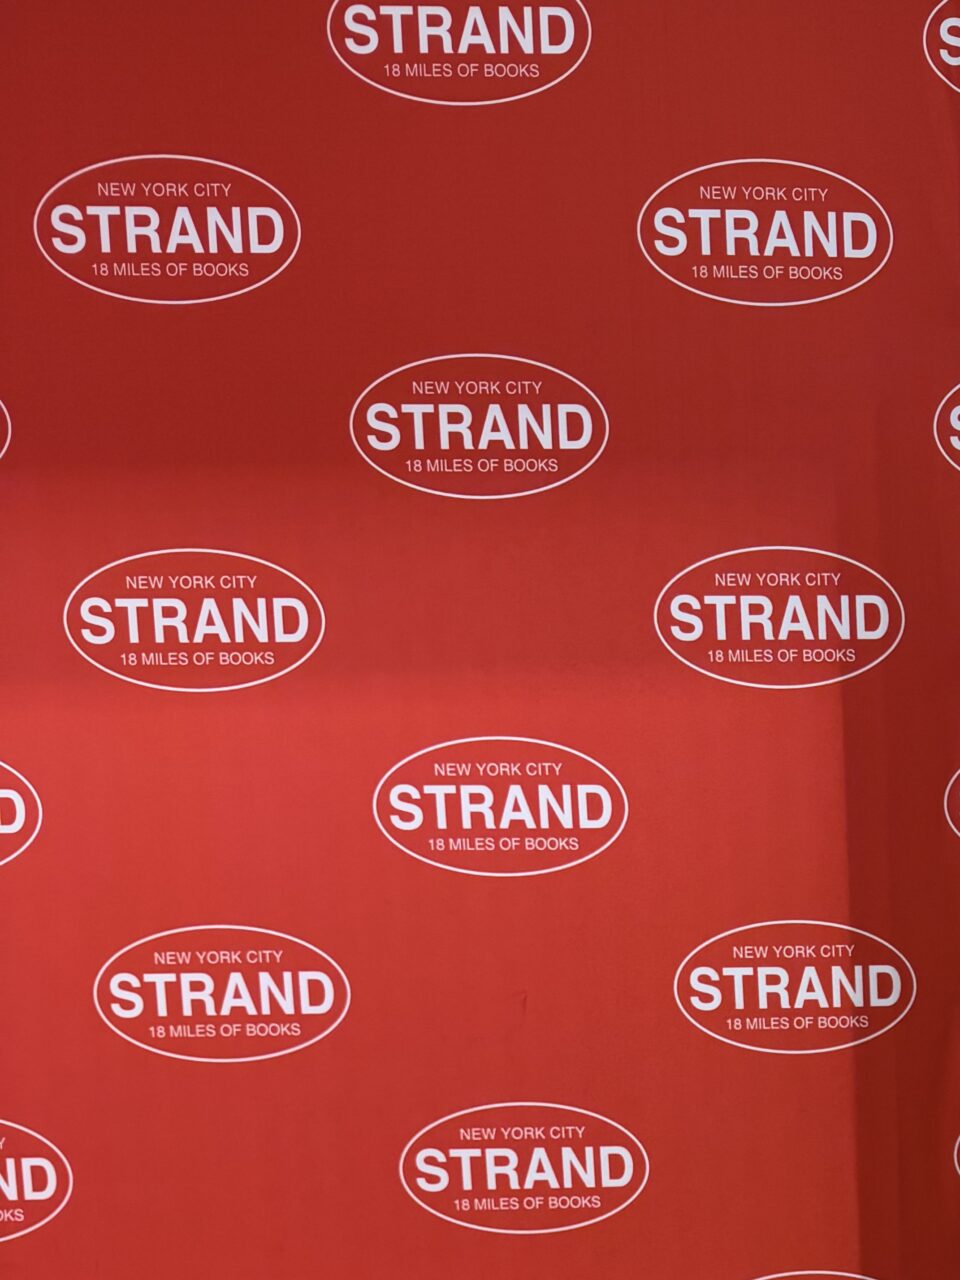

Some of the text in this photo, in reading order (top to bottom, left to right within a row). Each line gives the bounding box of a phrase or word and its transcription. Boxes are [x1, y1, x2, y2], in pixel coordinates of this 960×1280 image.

[344, 4, 574, 54] STRAND
[384, 63, 539, 77] 18 MILES OF BOOKS
[98, 183, 231, 196] NEW YORK CITY
[700, 186, 828, 201] NEW YORK CITY
[51, 204, 284, 254] STRAND
[654, 207, 877, 258] STRAND
[92, 263, 249, 276] 18 MILES OF BOOKS
[692, 265, 842, 280] 18 MILES OF BOOKS
[413, 381, 542, 394] NEW YORK CITY
[366, 403, 592, 451] STRAND
[406, 459, 558, 472] 18 MILES OF BOOKS
[126, 576, 257, 589] NEW YORK CITY
[715, 573, 840, 586] NEW YORK CITY
[80, 597, 308, 644] STRAND
[670, 594, 889, 641] STRAND
[121, 652, 274, 665] 18 MILES OF BOOKS
[708, 649, 855, 662] 18 MILES OF BOOKS
[434, 763, 562, 776] NEW YORK CITY
[389, 784, 612, 830] STRAND
[429, 837, 579, 851] 18 MILES OF BOOKS
[154, 950, 283, 964] NEW YORK CITY
[733, 945, 854, 958] NEW YORK CITY
[109, 971, 334, 1018] STRAND
[690, 965, 901, 1011] STRAND
[727, 1016, 868, 1030] 18 MILES OF BOOKS
[149, 1023, 301, 1038] 18 MILES OF BOOKS
[460, 1126, 585, 1140] NEW YORK CITY
[415, 1146, 633, 1192] STRAND
[454, 1196, 601, 1211] 18 MILES OF BOOKS
